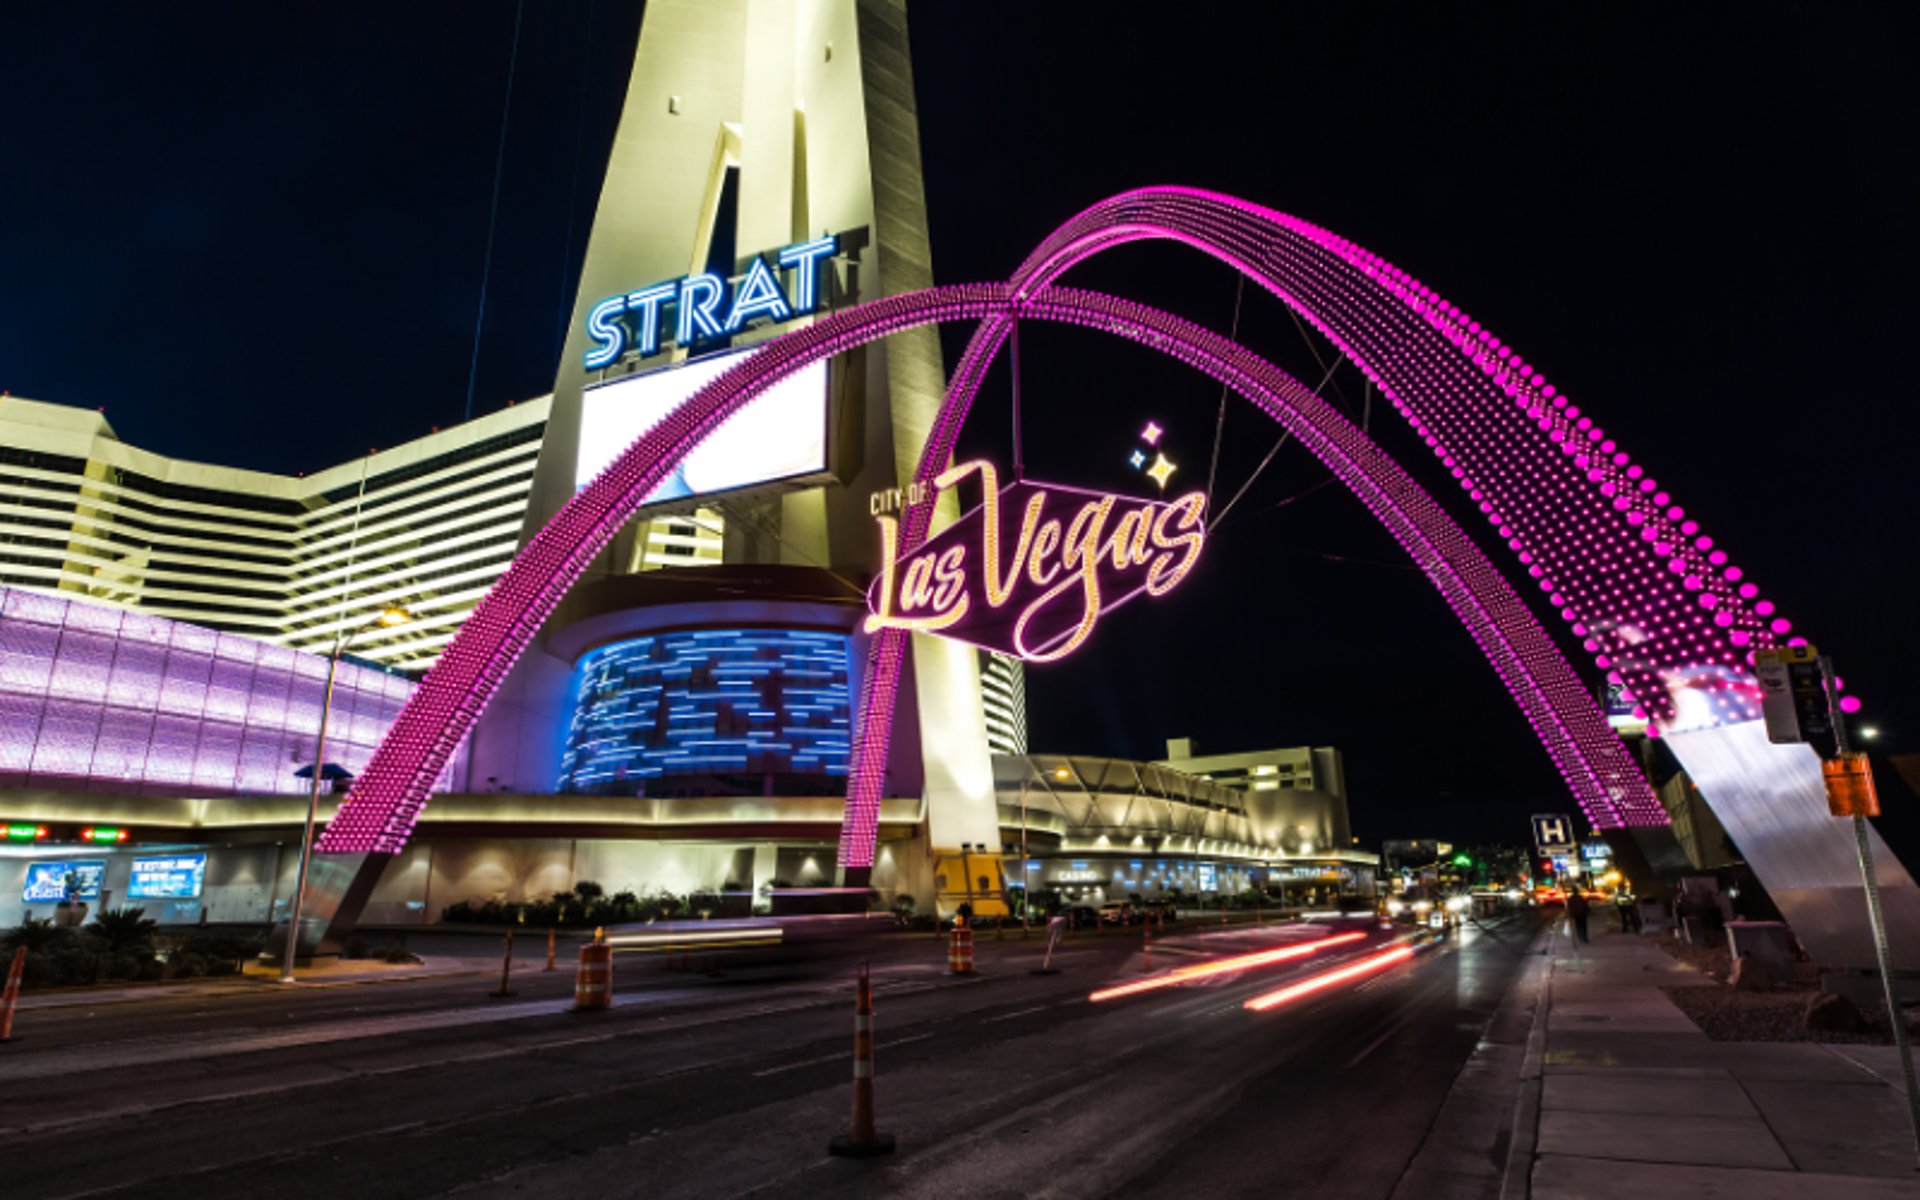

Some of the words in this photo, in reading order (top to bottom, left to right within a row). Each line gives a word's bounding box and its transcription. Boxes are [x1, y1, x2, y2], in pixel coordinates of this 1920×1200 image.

[584, 235, 836, 370] STRAT
[870, 488, 903, 516] CITY
[908, 480, 928, 506] OF
[863, 515, 968, 634] Las
[934, 459, 1206, 662] Vegas
[1541, 819, 1565, 843] H
